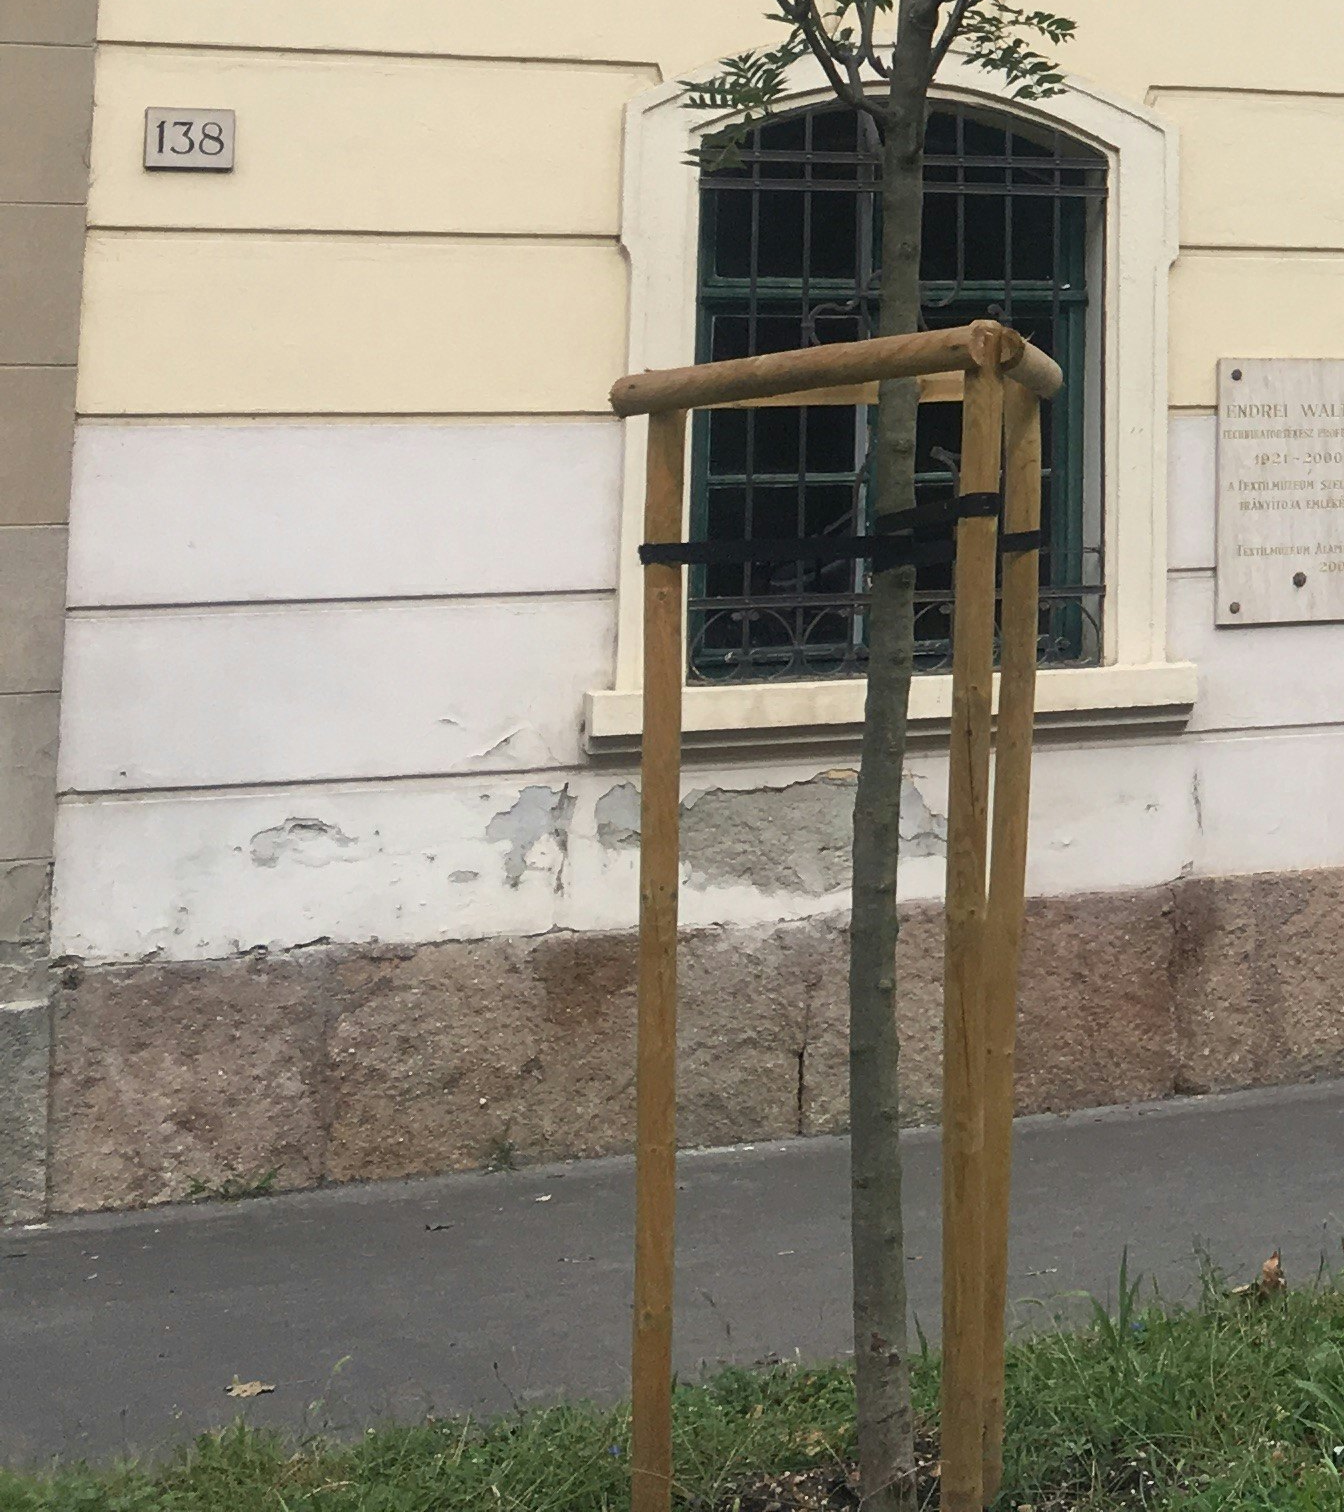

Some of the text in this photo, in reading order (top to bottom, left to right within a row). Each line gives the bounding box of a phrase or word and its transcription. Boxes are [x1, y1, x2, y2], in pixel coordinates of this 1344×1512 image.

[156, 120, 225, 156] 138
[1226, 402, 1289, 419] ENDREI
[1227, 481, 1234, 491] A
